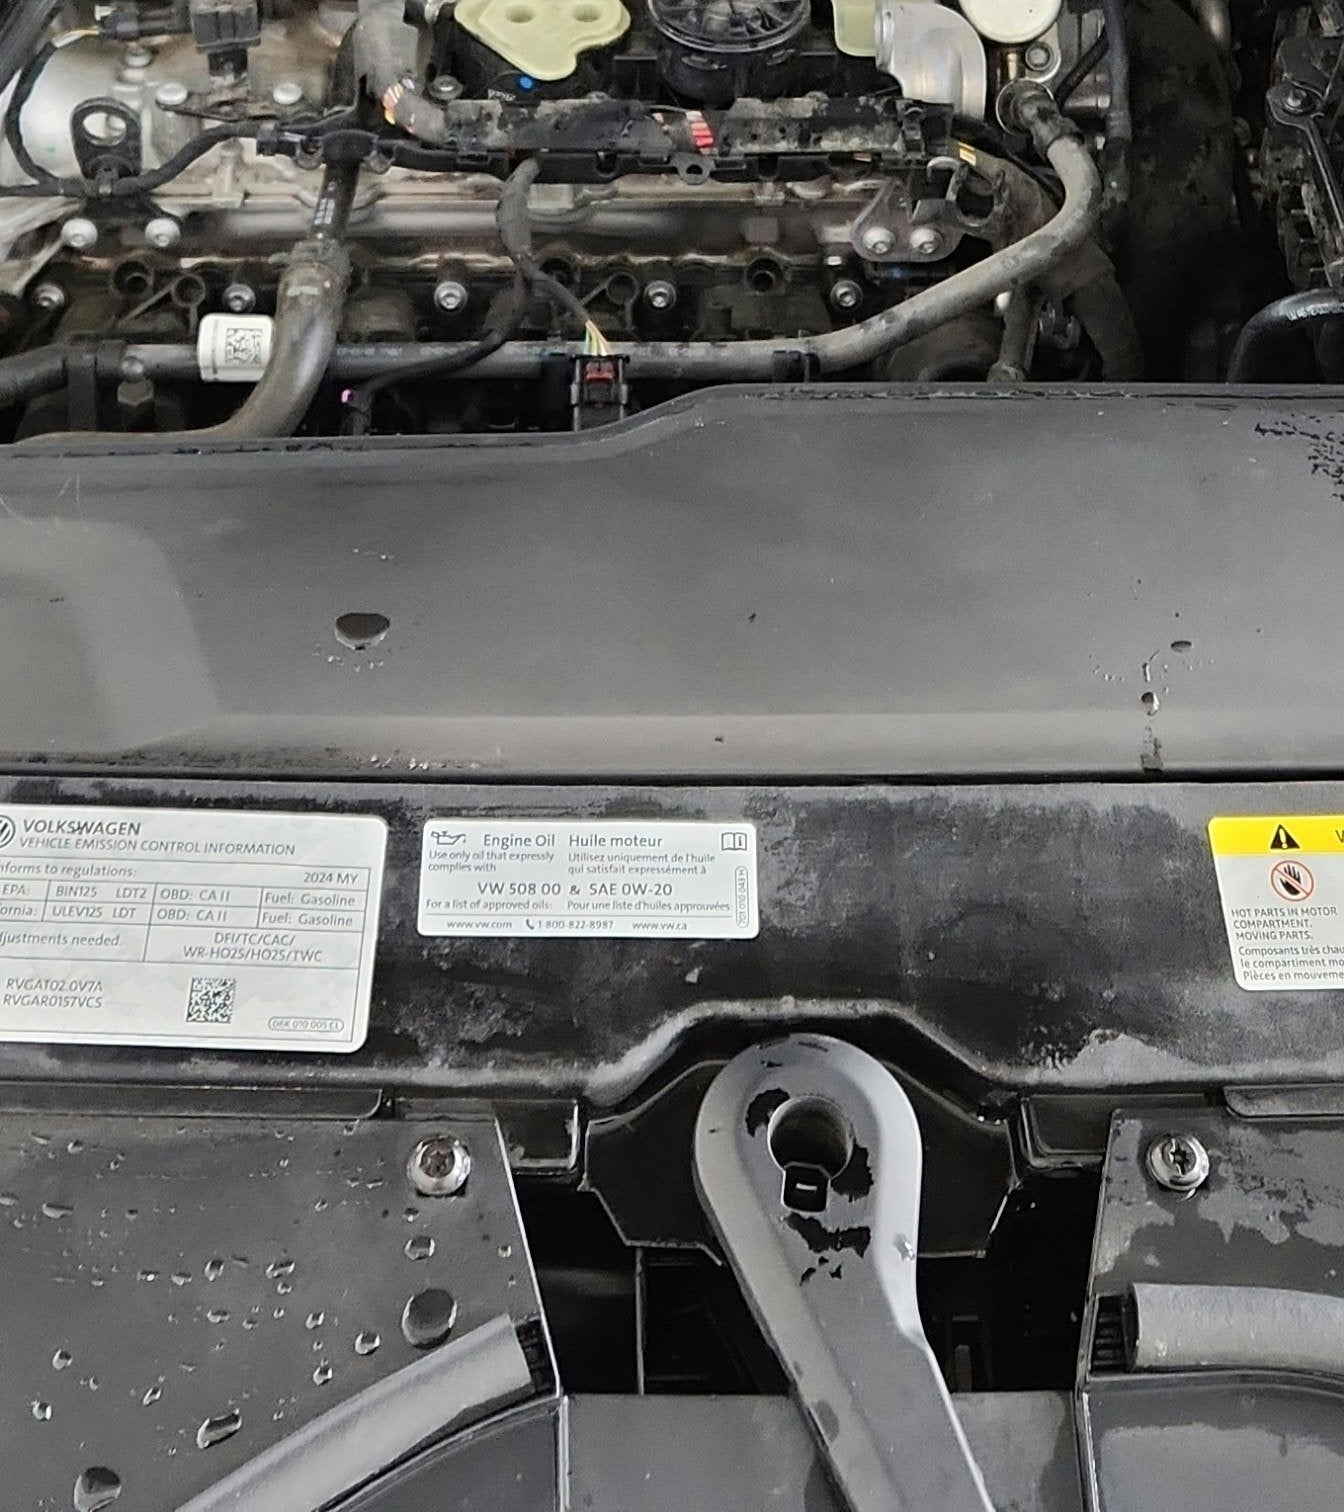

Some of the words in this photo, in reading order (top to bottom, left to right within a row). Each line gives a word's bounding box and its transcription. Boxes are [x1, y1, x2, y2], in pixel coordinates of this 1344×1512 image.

[24, 820, 140, 836] VOLKSWAGEN
[484, 834, 531, 850] Engine
[536, 834, 555, 846] Oil
[569, 834, 606, 846] Huile
[610, 835, 662, 846] moteur
[20, 838, 70, 849] VEHICLE
[75, 839, 136, 850] EMISSION
[141, 841, 200, 853] CONTROL
[204, 843, 295, 855] INFORMATION
[429, 851, 447, 860] Use
[450, 851, 471, 863] only
[473, 851, 484, 860] oil
[486, 851, 506, 860] that
[509, 851, 554, 863] expressly
[568, 852, 605, 862] Utilisez
[608, 853, 668, 864] uniquement
[671, 853, 683, 863] de
[686, 853, 715, 863] l'huile
[45, 864, 58, 874] to
[61, 864, 137, 878] regulations:
[428, 863, 471, 873] complies
[474, 863, 496, 872] with
[568, 864, 584, 874] qui
[586, 864, 626, 874] satisfait
[628, 864, 697, 875] expressément
[304, 872, 333, 882] 2024
[337, 874, 358, 884] MY
[3, 884, 29, 896] EPA:
[56, 886, 97, 898] BIN125
[116, 888, 147, 898] LDT2
[478, 882, 506, 895] VW
[509, 882, 536, 895] 508
[541, 883, 561, 895] 00
[570, 884, 580, 895] &
[590, 883, 617, 895] SAE
[621, 883, 672, 896] 0W-20
[160, 890, 192, 900] OBD:
[200, 891, 218, 901] CA
[265, 892, 295, 904] Fuel:
[301, 893, 355, 906] Gasoline
[426, 899, 442, 909] For
[452, 900, 467, 909] list
[470, 900, 480, 909] of
[482, 900, 529, 912] approved
[532, 900, 553, 910] oils:
[567, 900, 589, 910] Pour
[612, 901, 632, 910] liste
[635, 901, 672, 911] d'huiles
[53, 906, 103, 918] ULEV125
[113, 908, 137, 919] LDT
[157, 909, 190, 920] OBD:
[196, 910, 215, 922] CA
[1231, 909, 1251, 917] HOT
[1255, 908, 1286, 917] PARTS
[1288, 908, 1298, 916] IN
[1301, 907, 1337, 916] MOTOR
[262, 912, 292, 924] Fuel:
[298, 913, 353, 926] Gasoline
[1233, 918, 1313, 929] COMPARTMENT.
[632, 922, 687, 930] www.vw.ca
[72, 936, 122, 946] needed.
[214, 932, 296, 946] DFI/TC/CAC/
[1236, 931, 1277, 941] MOVING
[1279, 930, 1314, 939] PARTS.
[1238, 946, 1299, 957] Composants
[1301, 945, 1320, 955] très
[1241, 959, 1250, 968] le
[1253, 958, 1326, 969] compartiment
[1243, 971, 1276, 980] Pièces
